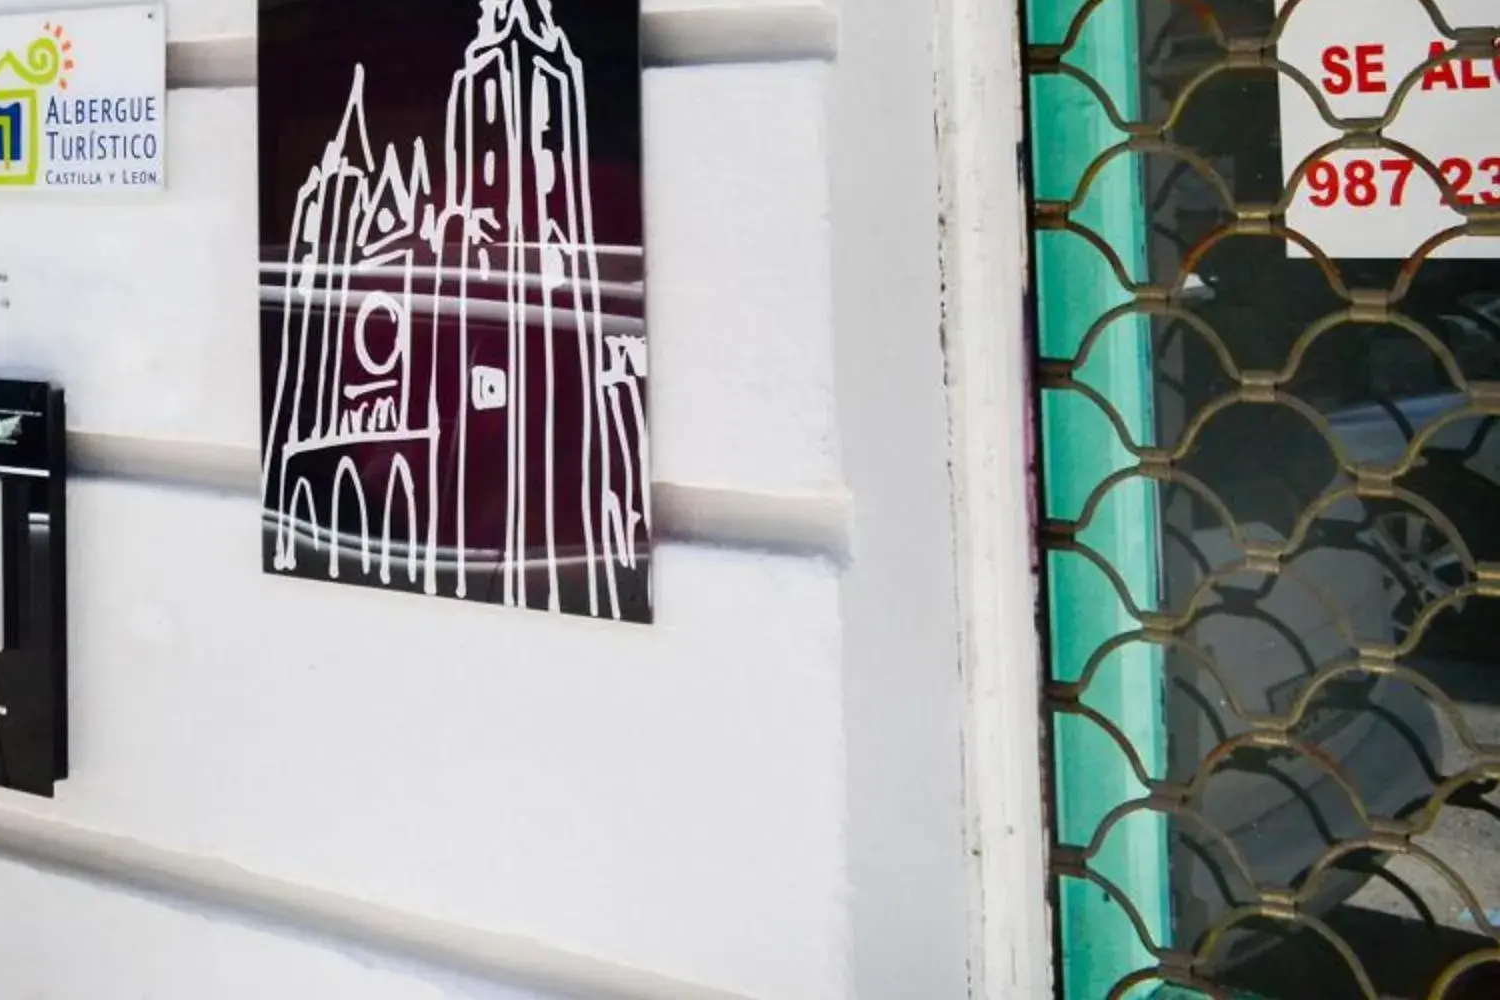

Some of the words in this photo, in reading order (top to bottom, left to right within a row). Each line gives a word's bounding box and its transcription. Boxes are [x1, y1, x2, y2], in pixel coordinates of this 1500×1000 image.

[1321, 44, 1386, 95] SE
[1421, 41, 1500, 90] AL
[45, 96, 156, 125] ALBERGUE
[46, 130, 157, 161] TURÍSTICO
[45, 170, 103, 186] CASTILLA
[108, 171, 116, 184] Y
[1305, 158, 1413, 207] 987
